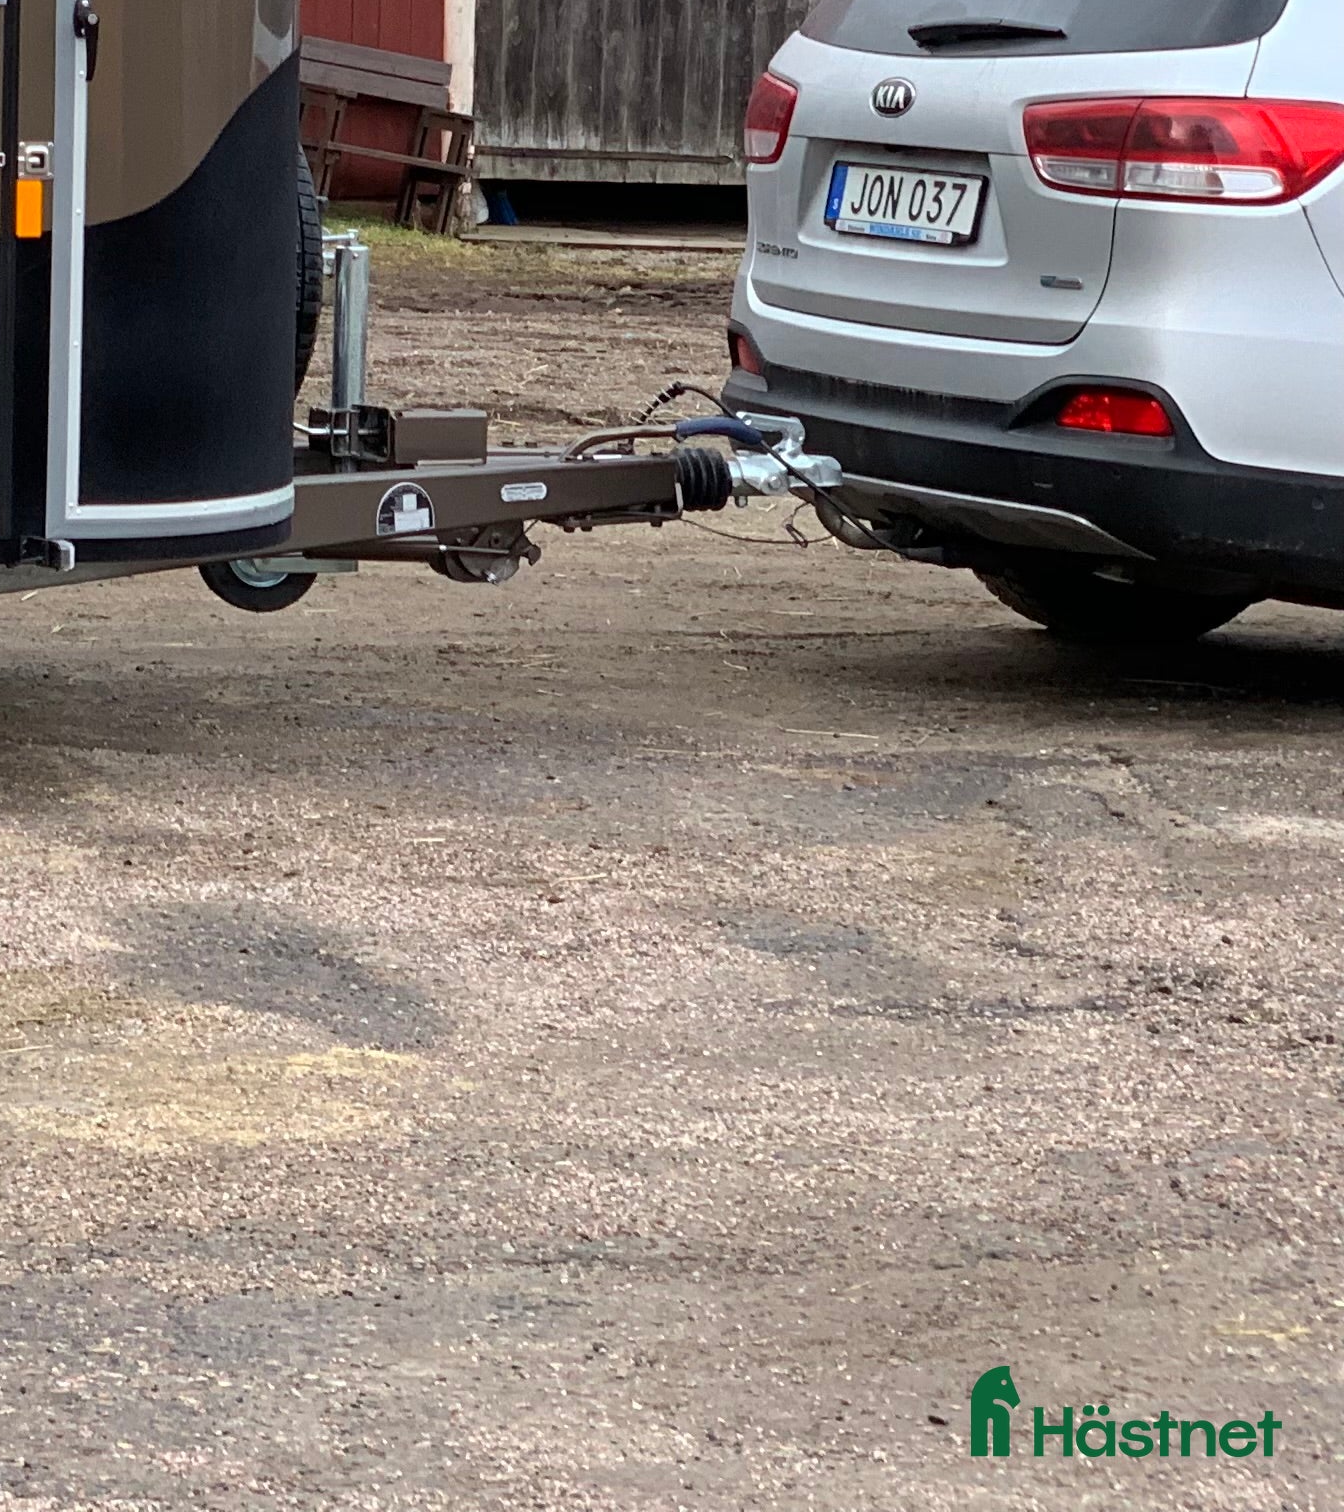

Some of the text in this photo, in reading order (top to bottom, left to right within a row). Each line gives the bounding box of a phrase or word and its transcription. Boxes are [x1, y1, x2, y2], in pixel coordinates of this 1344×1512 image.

[875, 85, 905, 109] KIA
[832, 198, 839, 210] S
[850, 173, 968, 226] JON 037
